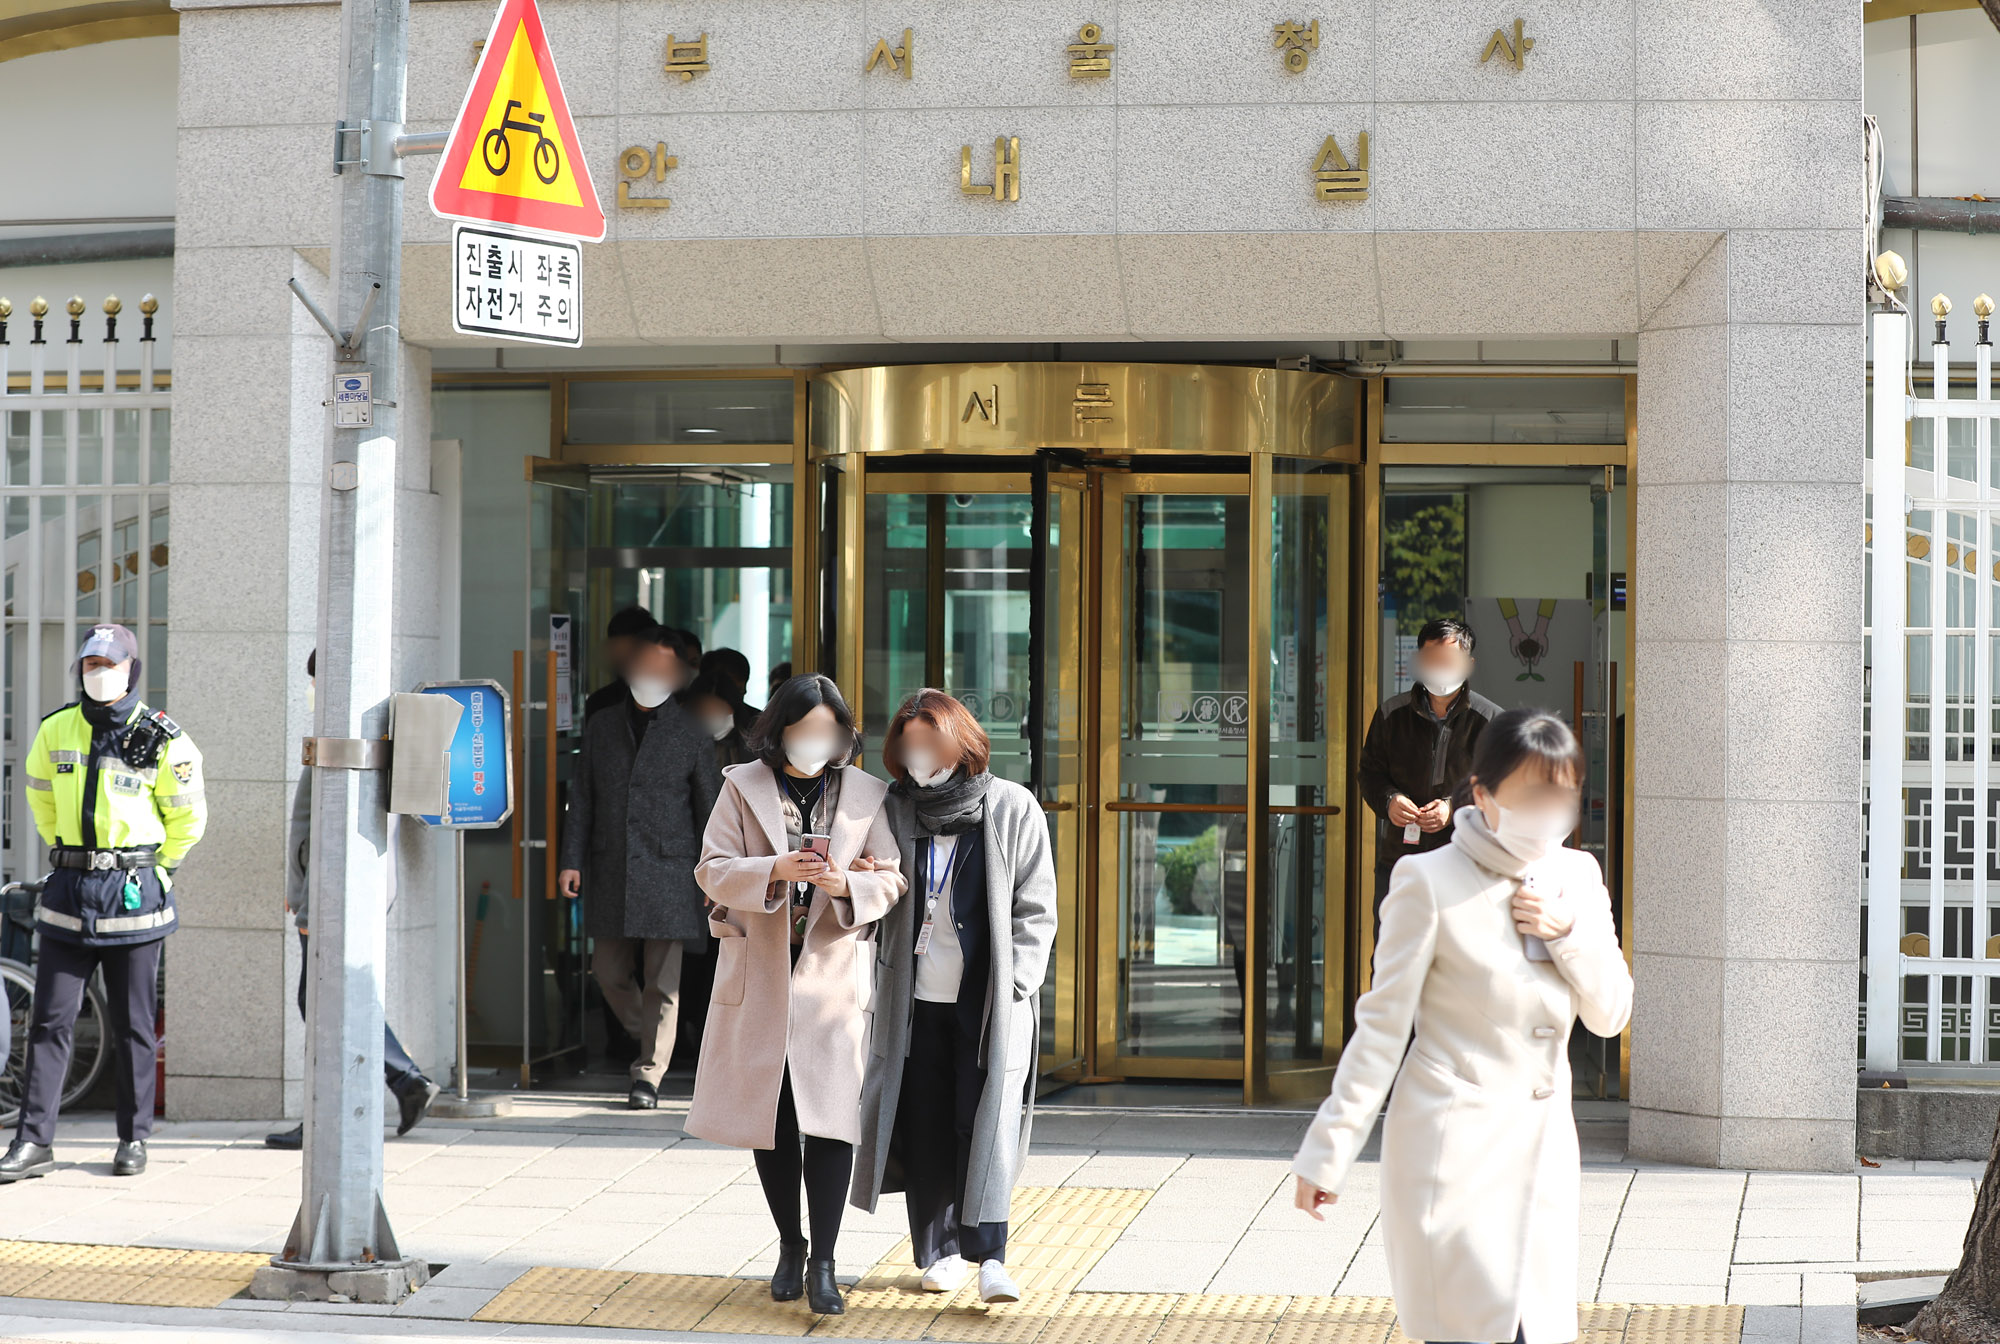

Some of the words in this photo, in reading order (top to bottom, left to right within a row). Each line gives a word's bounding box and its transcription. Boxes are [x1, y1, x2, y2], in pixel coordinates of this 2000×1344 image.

[664, 32, 709, 81] 부
[866, 27, 912, 78] 서
[1066, 22, 1115, 78] 울
[1275, 19, 1319, 73] 청
[1481, 17, 1534, 70] 사
[618, 141, 678, 208] 안
[961, 135, 1020, 202] 내
[1311, 131, 1370, 201] 실
[466, 243, 522, 283] 진출시
[537, 253, 572, 290] 좌측
[465, 284, 523, 324] 자전거
[537, 294, 572, 331] 주의
[961, 384, 999, 426] 서
